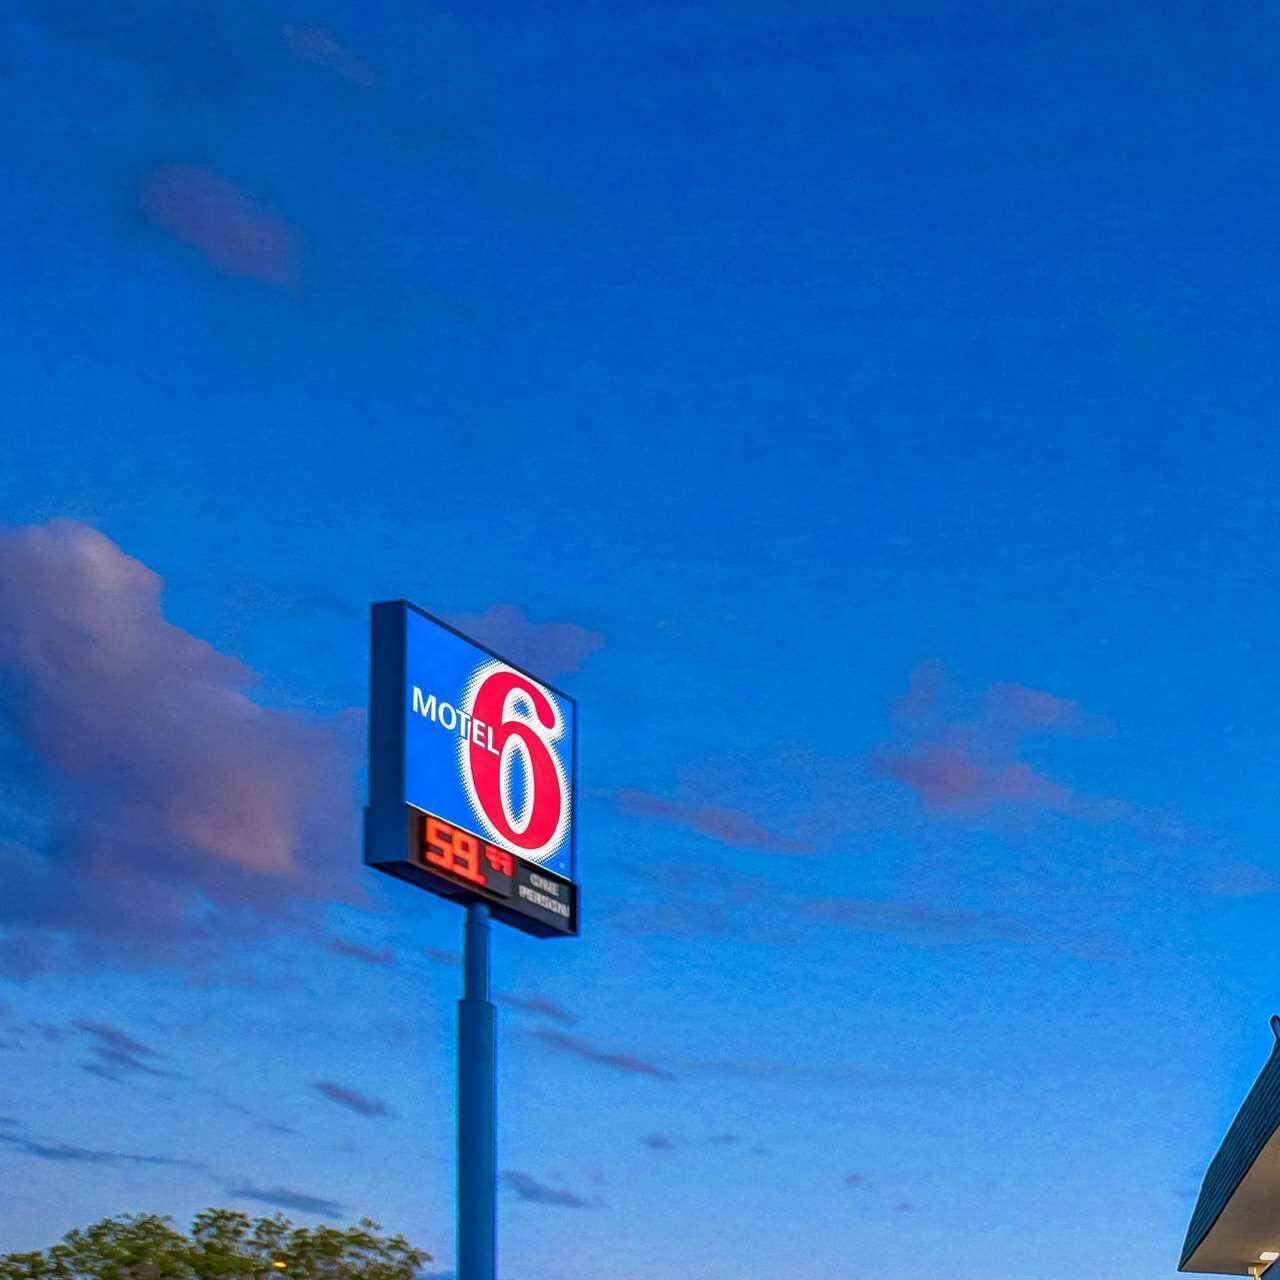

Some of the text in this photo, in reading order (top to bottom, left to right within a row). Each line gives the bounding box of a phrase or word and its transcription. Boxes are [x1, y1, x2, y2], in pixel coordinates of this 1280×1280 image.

[412, 671, 562, 850] MOTEL 6
[519, 885, 571, 919] PERSON
